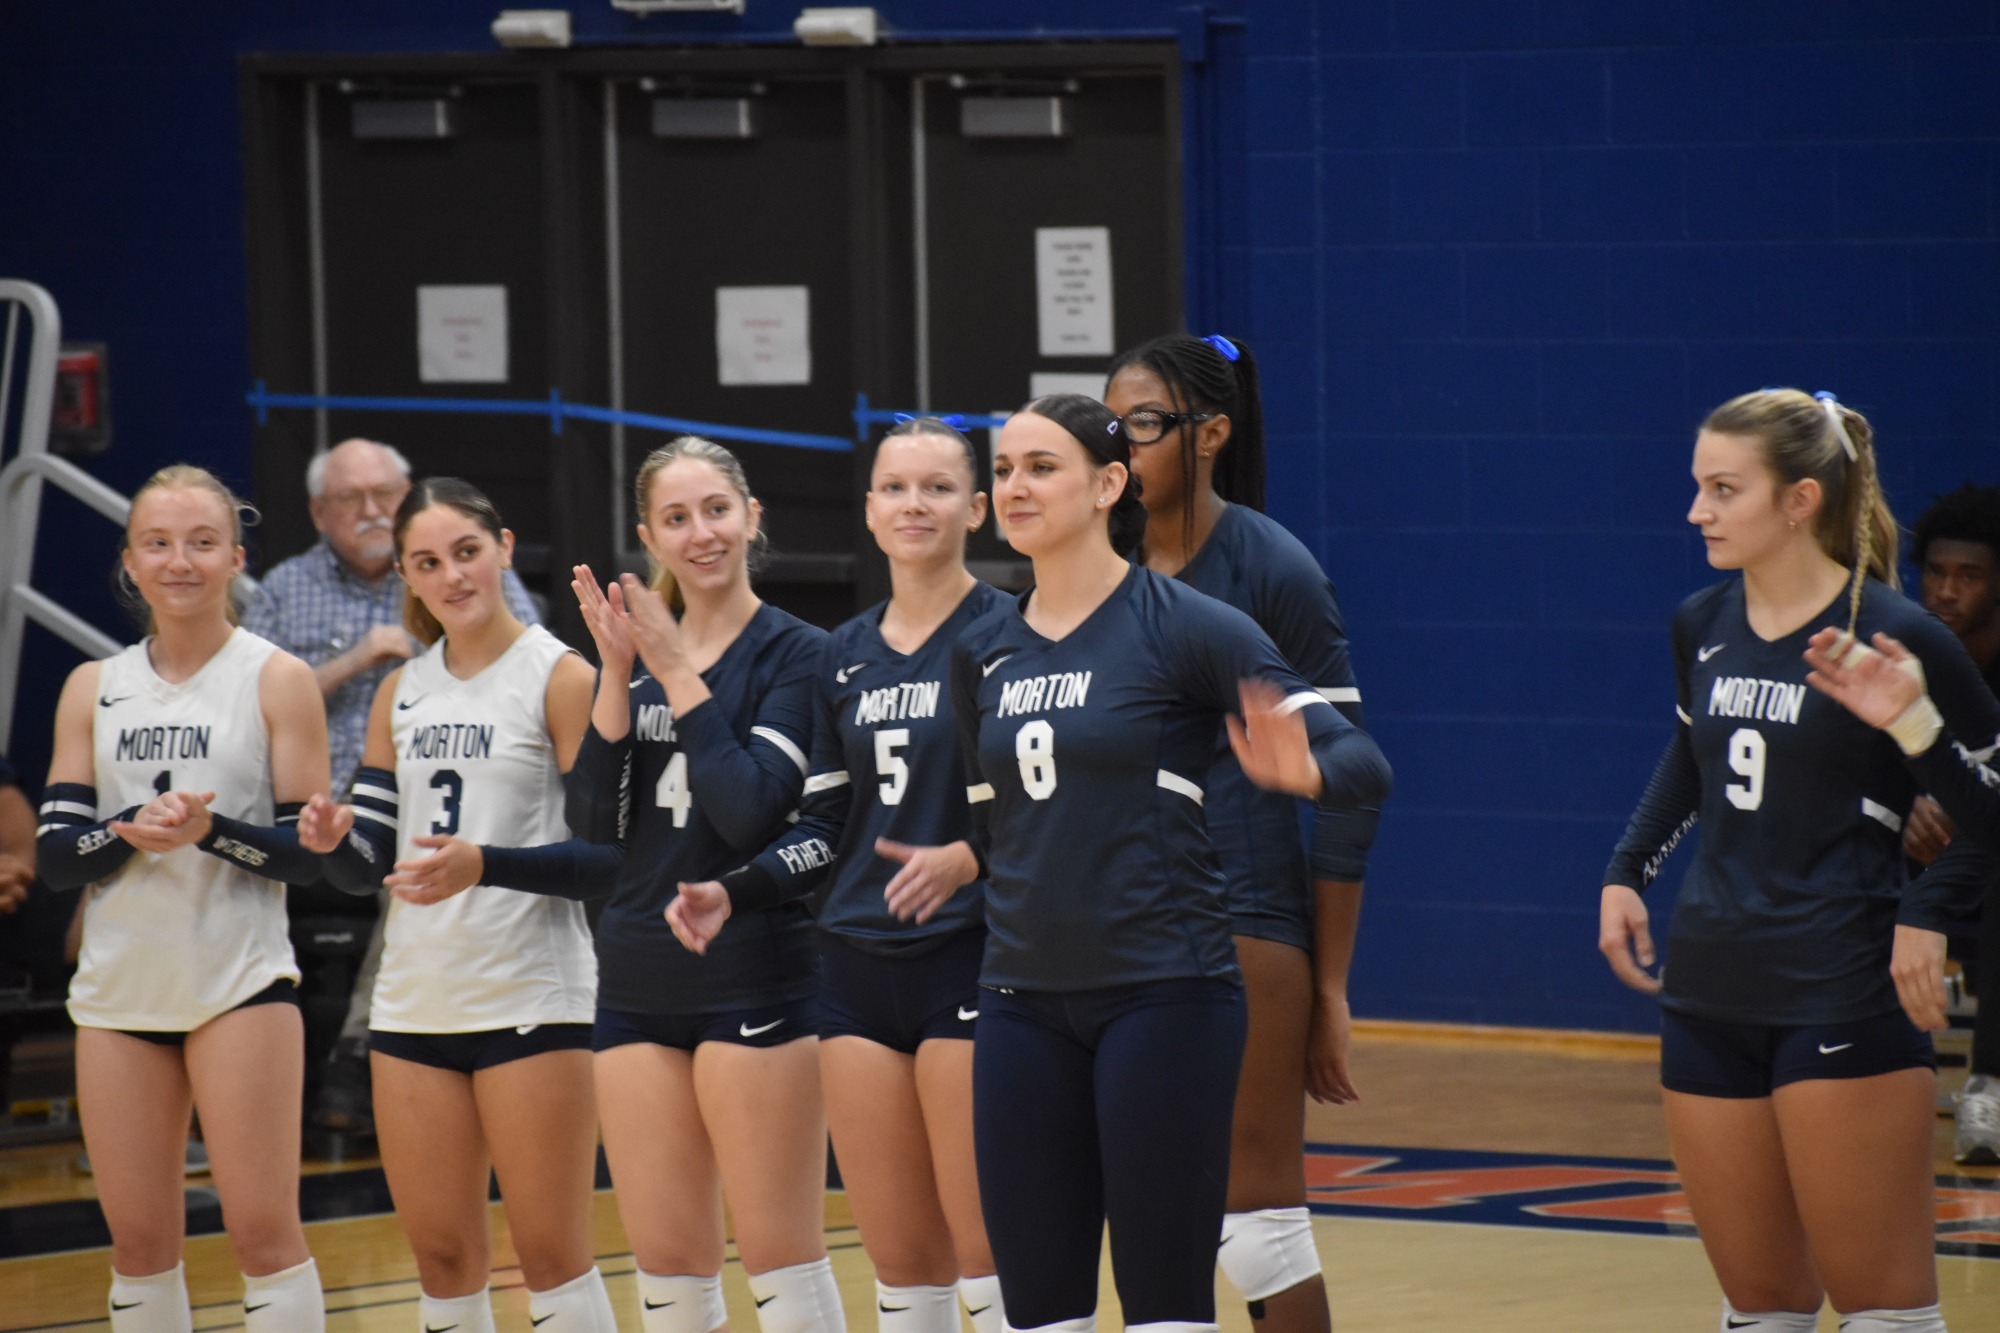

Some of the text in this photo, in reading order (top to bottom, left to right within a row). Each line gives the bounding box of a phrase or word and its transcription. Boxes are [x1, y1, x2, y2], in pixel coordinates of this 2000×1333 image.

[855, 681, 941, 727] MORTON
[997, 670, 1092, 719] MORTON
[1708, 676, 1807, 725] MORTON
[116, 725, 211, 762] MORTON
[406, 724, 495, 760] MORTON
[874, 728, 910, 806] 5
[1016, 719, 1057, 801] 8
[1725, 727, 1767, 812] 9
[429, 769, 463, 836] 3
[655, 751, 692, 828] 4
